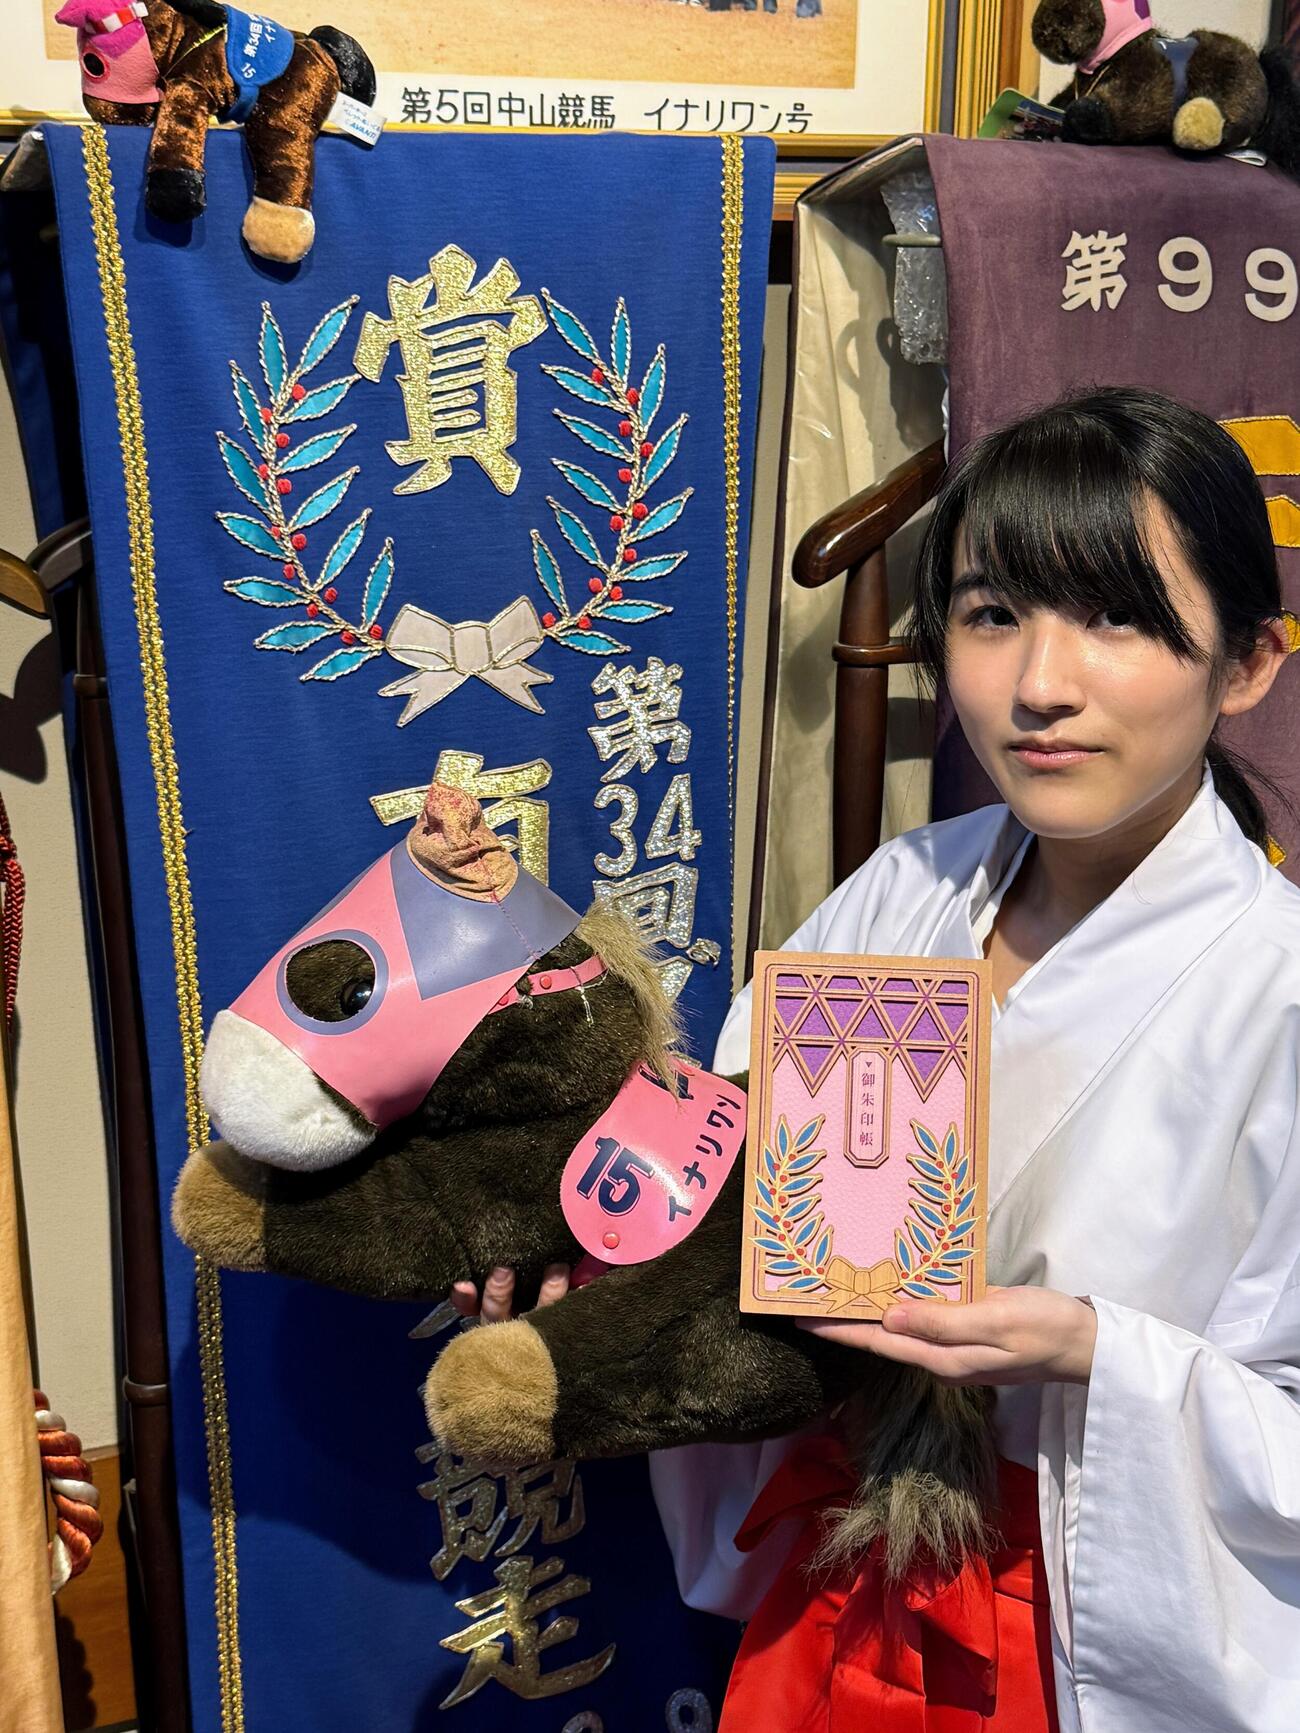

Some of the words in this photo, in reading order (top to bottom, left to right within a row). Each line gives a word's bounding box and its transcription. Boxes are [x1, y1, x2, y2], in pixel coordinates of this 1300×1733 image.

[241, 62, 256, 79] 15
[400, 86, 616, 128] 第5回中山競馬
[643, 97, 813, 134] イナリワン号
[353, 243, 549, 496] 賞
[859, 1072, 876, 1147] 御朱印帳
[576, 1137, 655, 1216] 15
[669, 1093, 742, 1222] イナリワン
